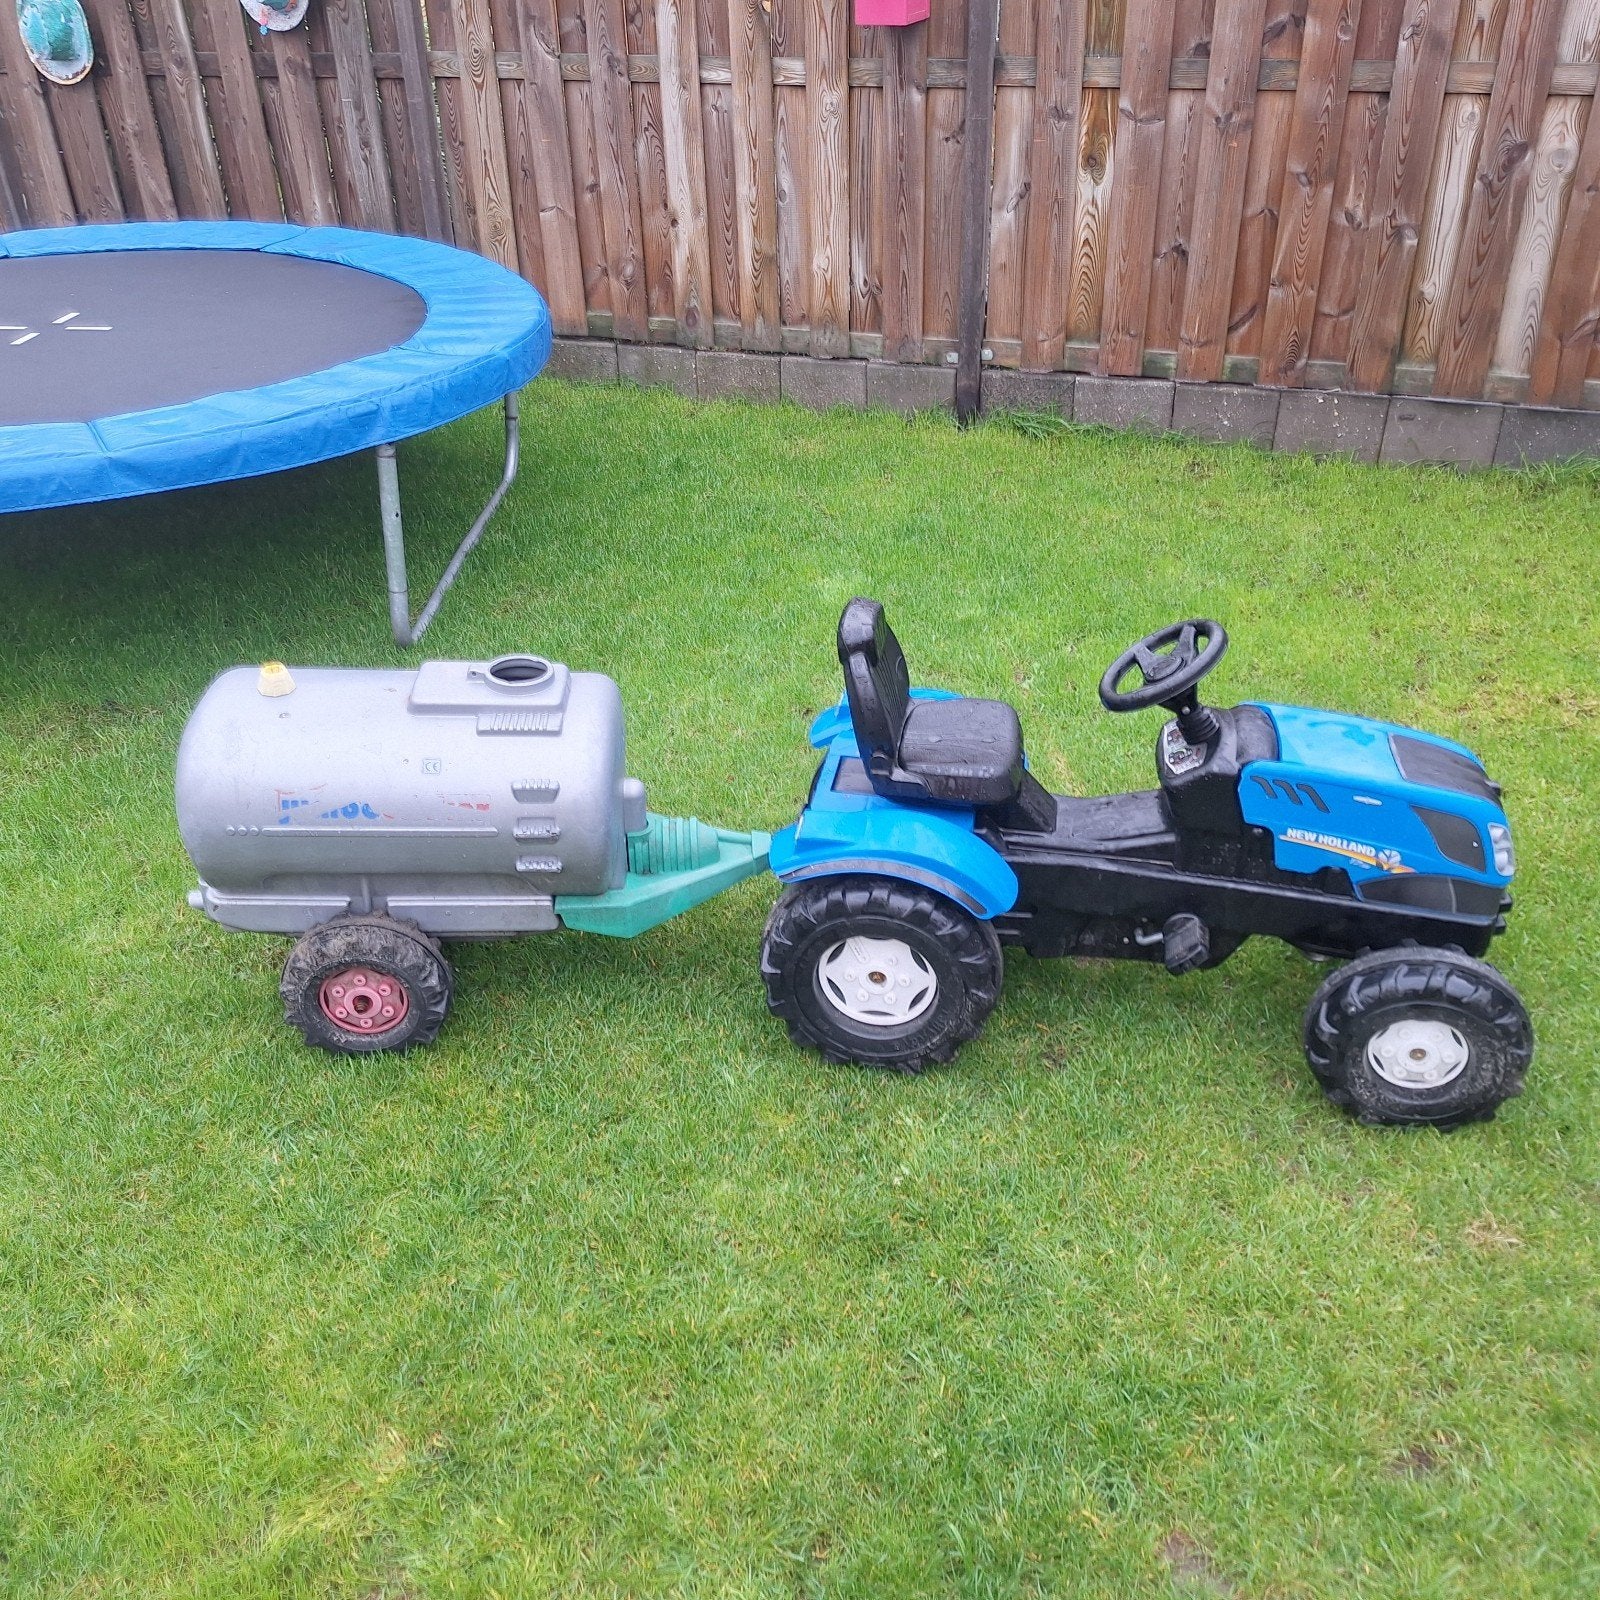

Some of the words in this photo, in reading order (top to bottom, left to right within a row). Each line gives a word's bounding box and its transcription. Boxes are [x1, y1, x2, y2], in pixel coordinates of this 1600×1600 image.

[424, 761, 440, 773] CE
[1286, 827, 1317, 843] NEW
[1318, 834, 1376, 857] HOLLAND
